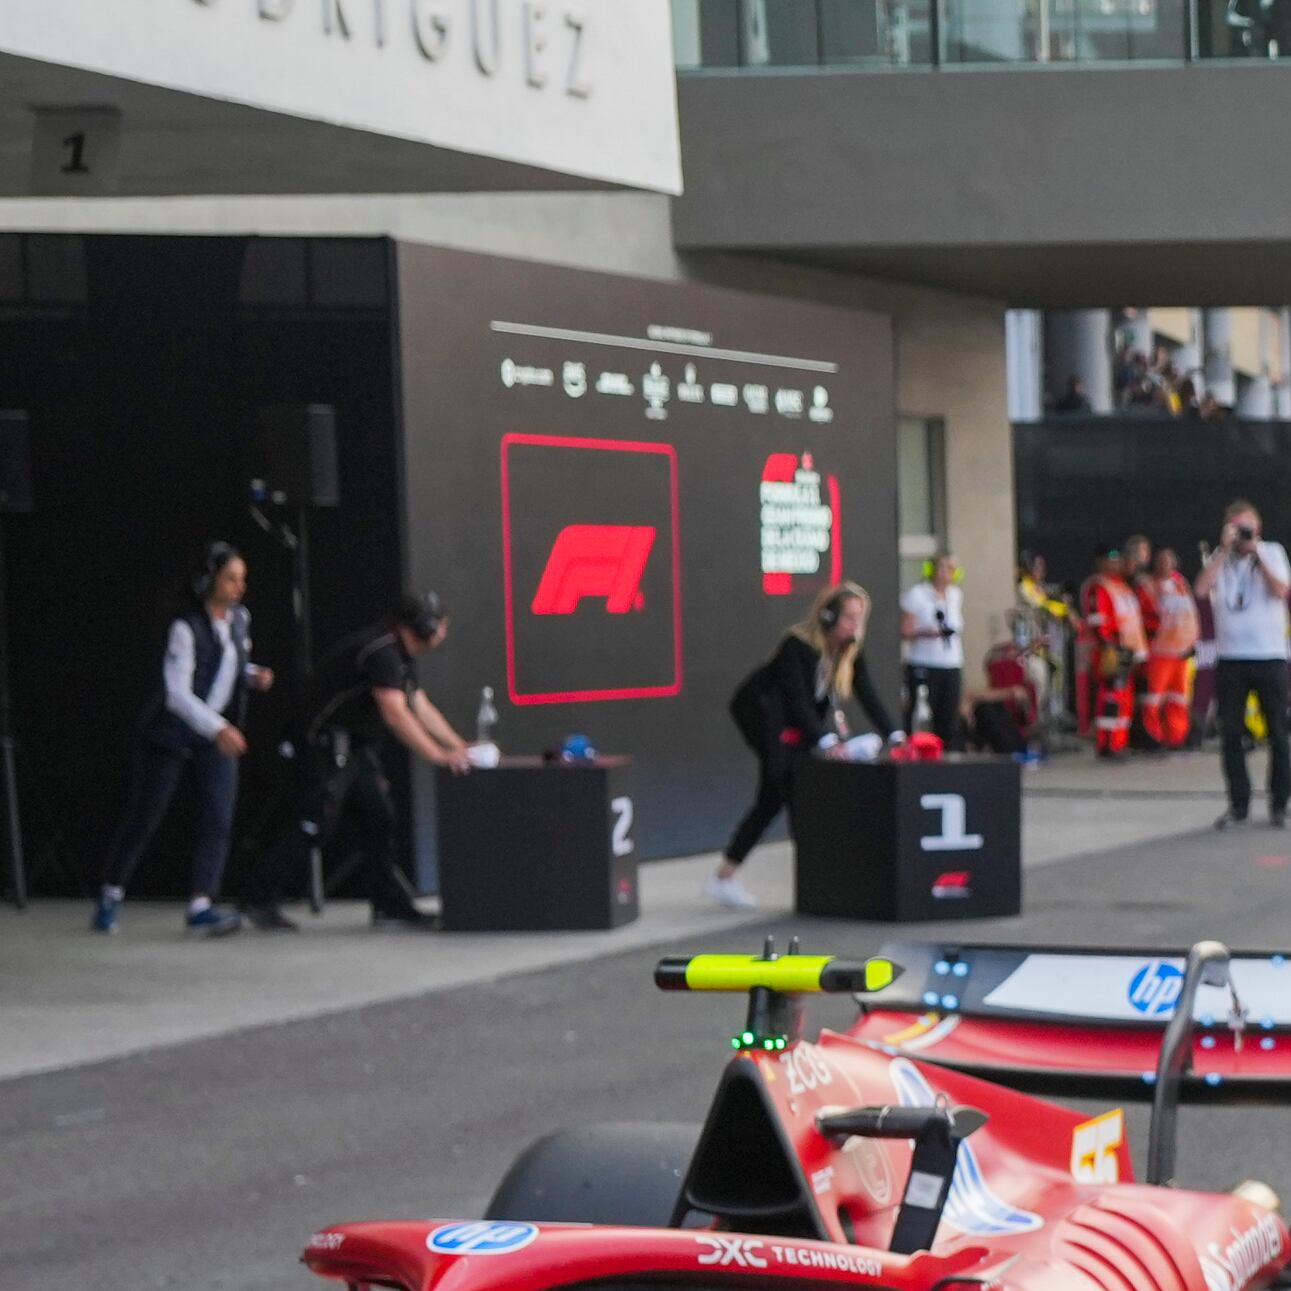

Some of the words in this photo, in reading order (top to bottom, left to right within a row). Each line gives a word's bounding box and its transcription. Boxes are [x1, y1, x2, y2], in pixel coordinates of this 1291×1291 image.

[60, 132, 90, 174] 1
[611, 796, 635, 857] 2
[919, 793, 985, 852] 1
[1128, 961, 1182, 1014] hp
[1070, 1108, 1125, 1185] 55
[430, 1218, 537, 1253] hp
[695, 1236, 769, 1269] DXC
[771, 1245, 884, 1278] TECHNOLOGY
